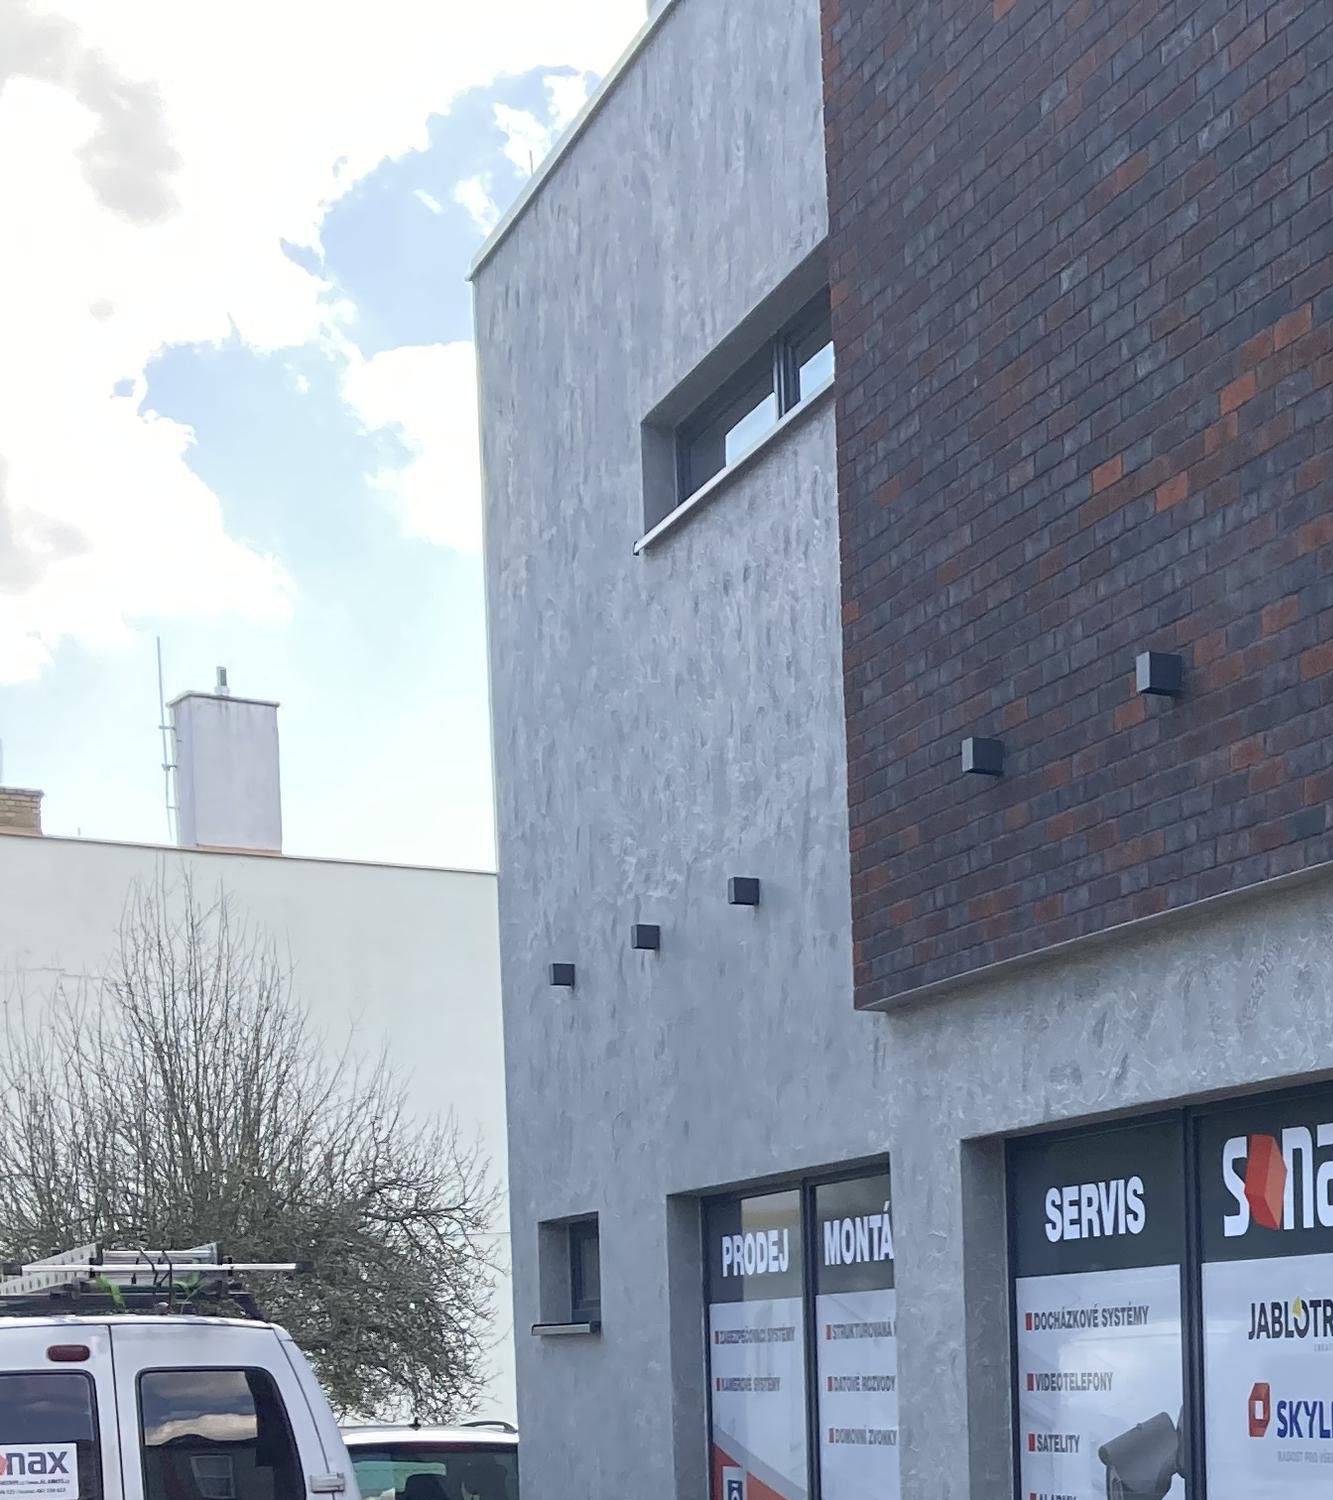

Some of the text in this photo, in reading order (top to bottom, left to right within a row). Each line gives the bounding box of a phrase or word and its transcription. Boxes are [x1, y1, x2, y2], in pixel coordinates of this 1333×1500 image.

[1045, 1176, 1145, 1242] SERVIS
[824, 1201, 894, 1266] MONTÁ
[722, 1229, 788, 1277] PRODEJ
[1034, 1302, 1149, 1331] DOCHÁZKOVÉ SYSTÉMY
[1035, 1372, 1113, 1391] VIDEOTELEFONY
[1036, 1433, 1079, 1453] SATELITY
[0, 1451, 69, 1475] nax
